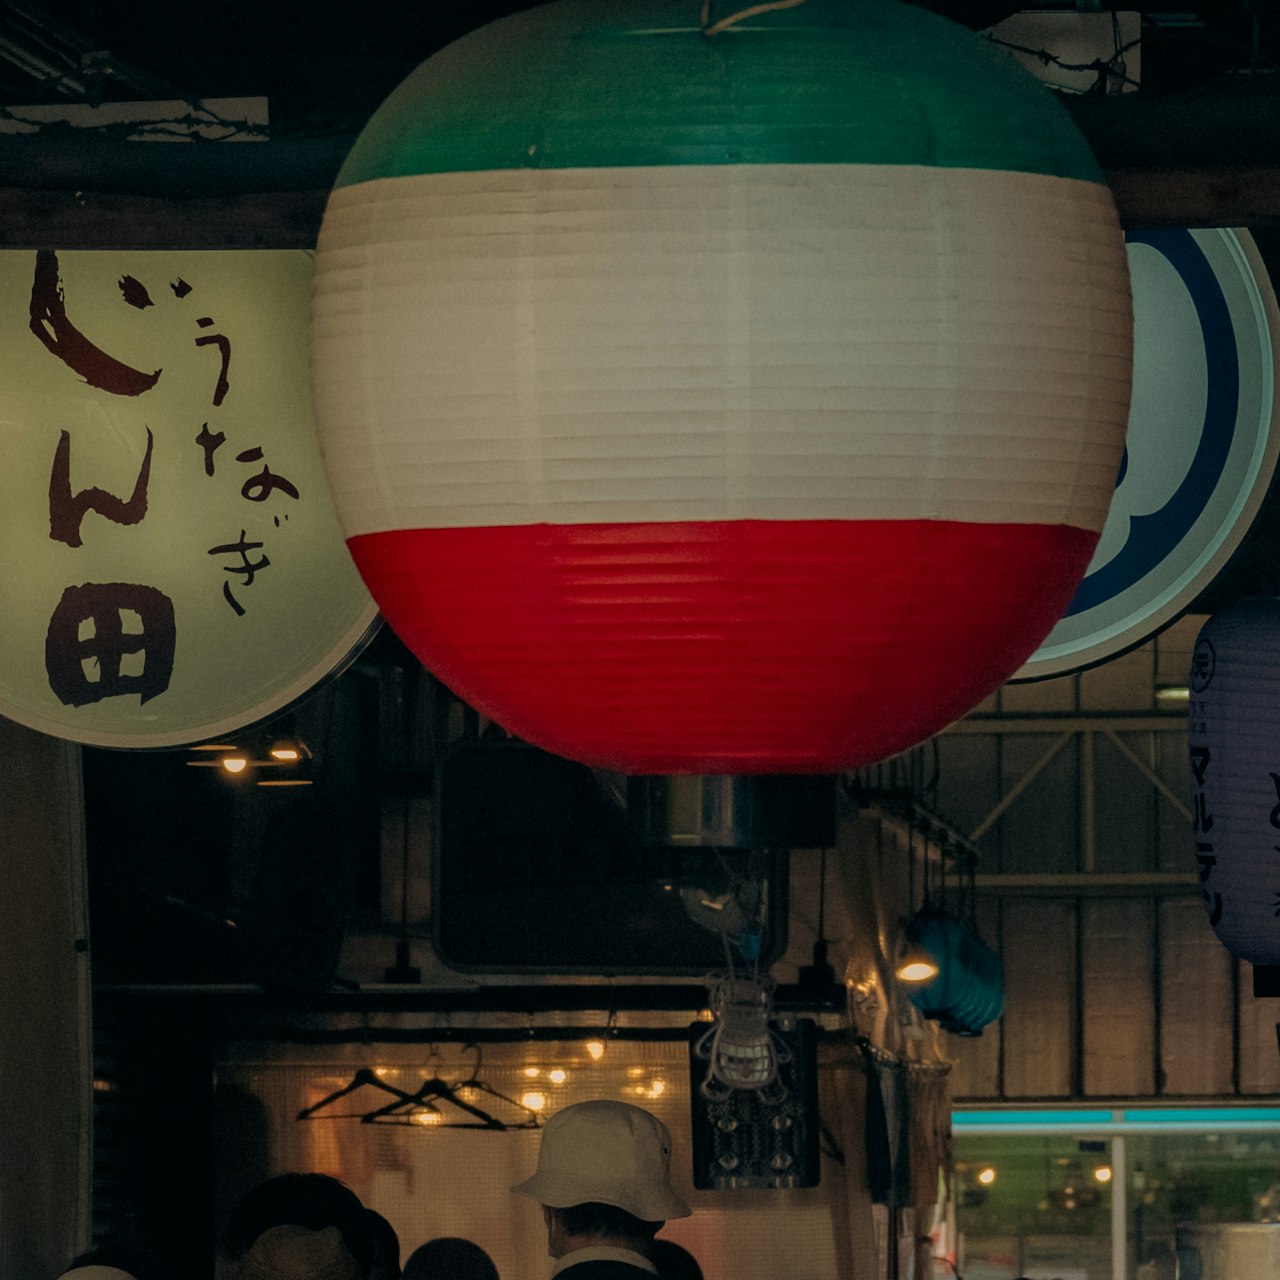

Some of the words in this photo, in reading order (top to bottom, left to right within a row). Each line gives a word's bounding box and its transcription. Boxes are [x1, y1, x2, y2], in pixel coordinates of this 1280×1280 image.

[29, 250, 192, 706] じん田
[195, 316, 300, 616] うなぎ
